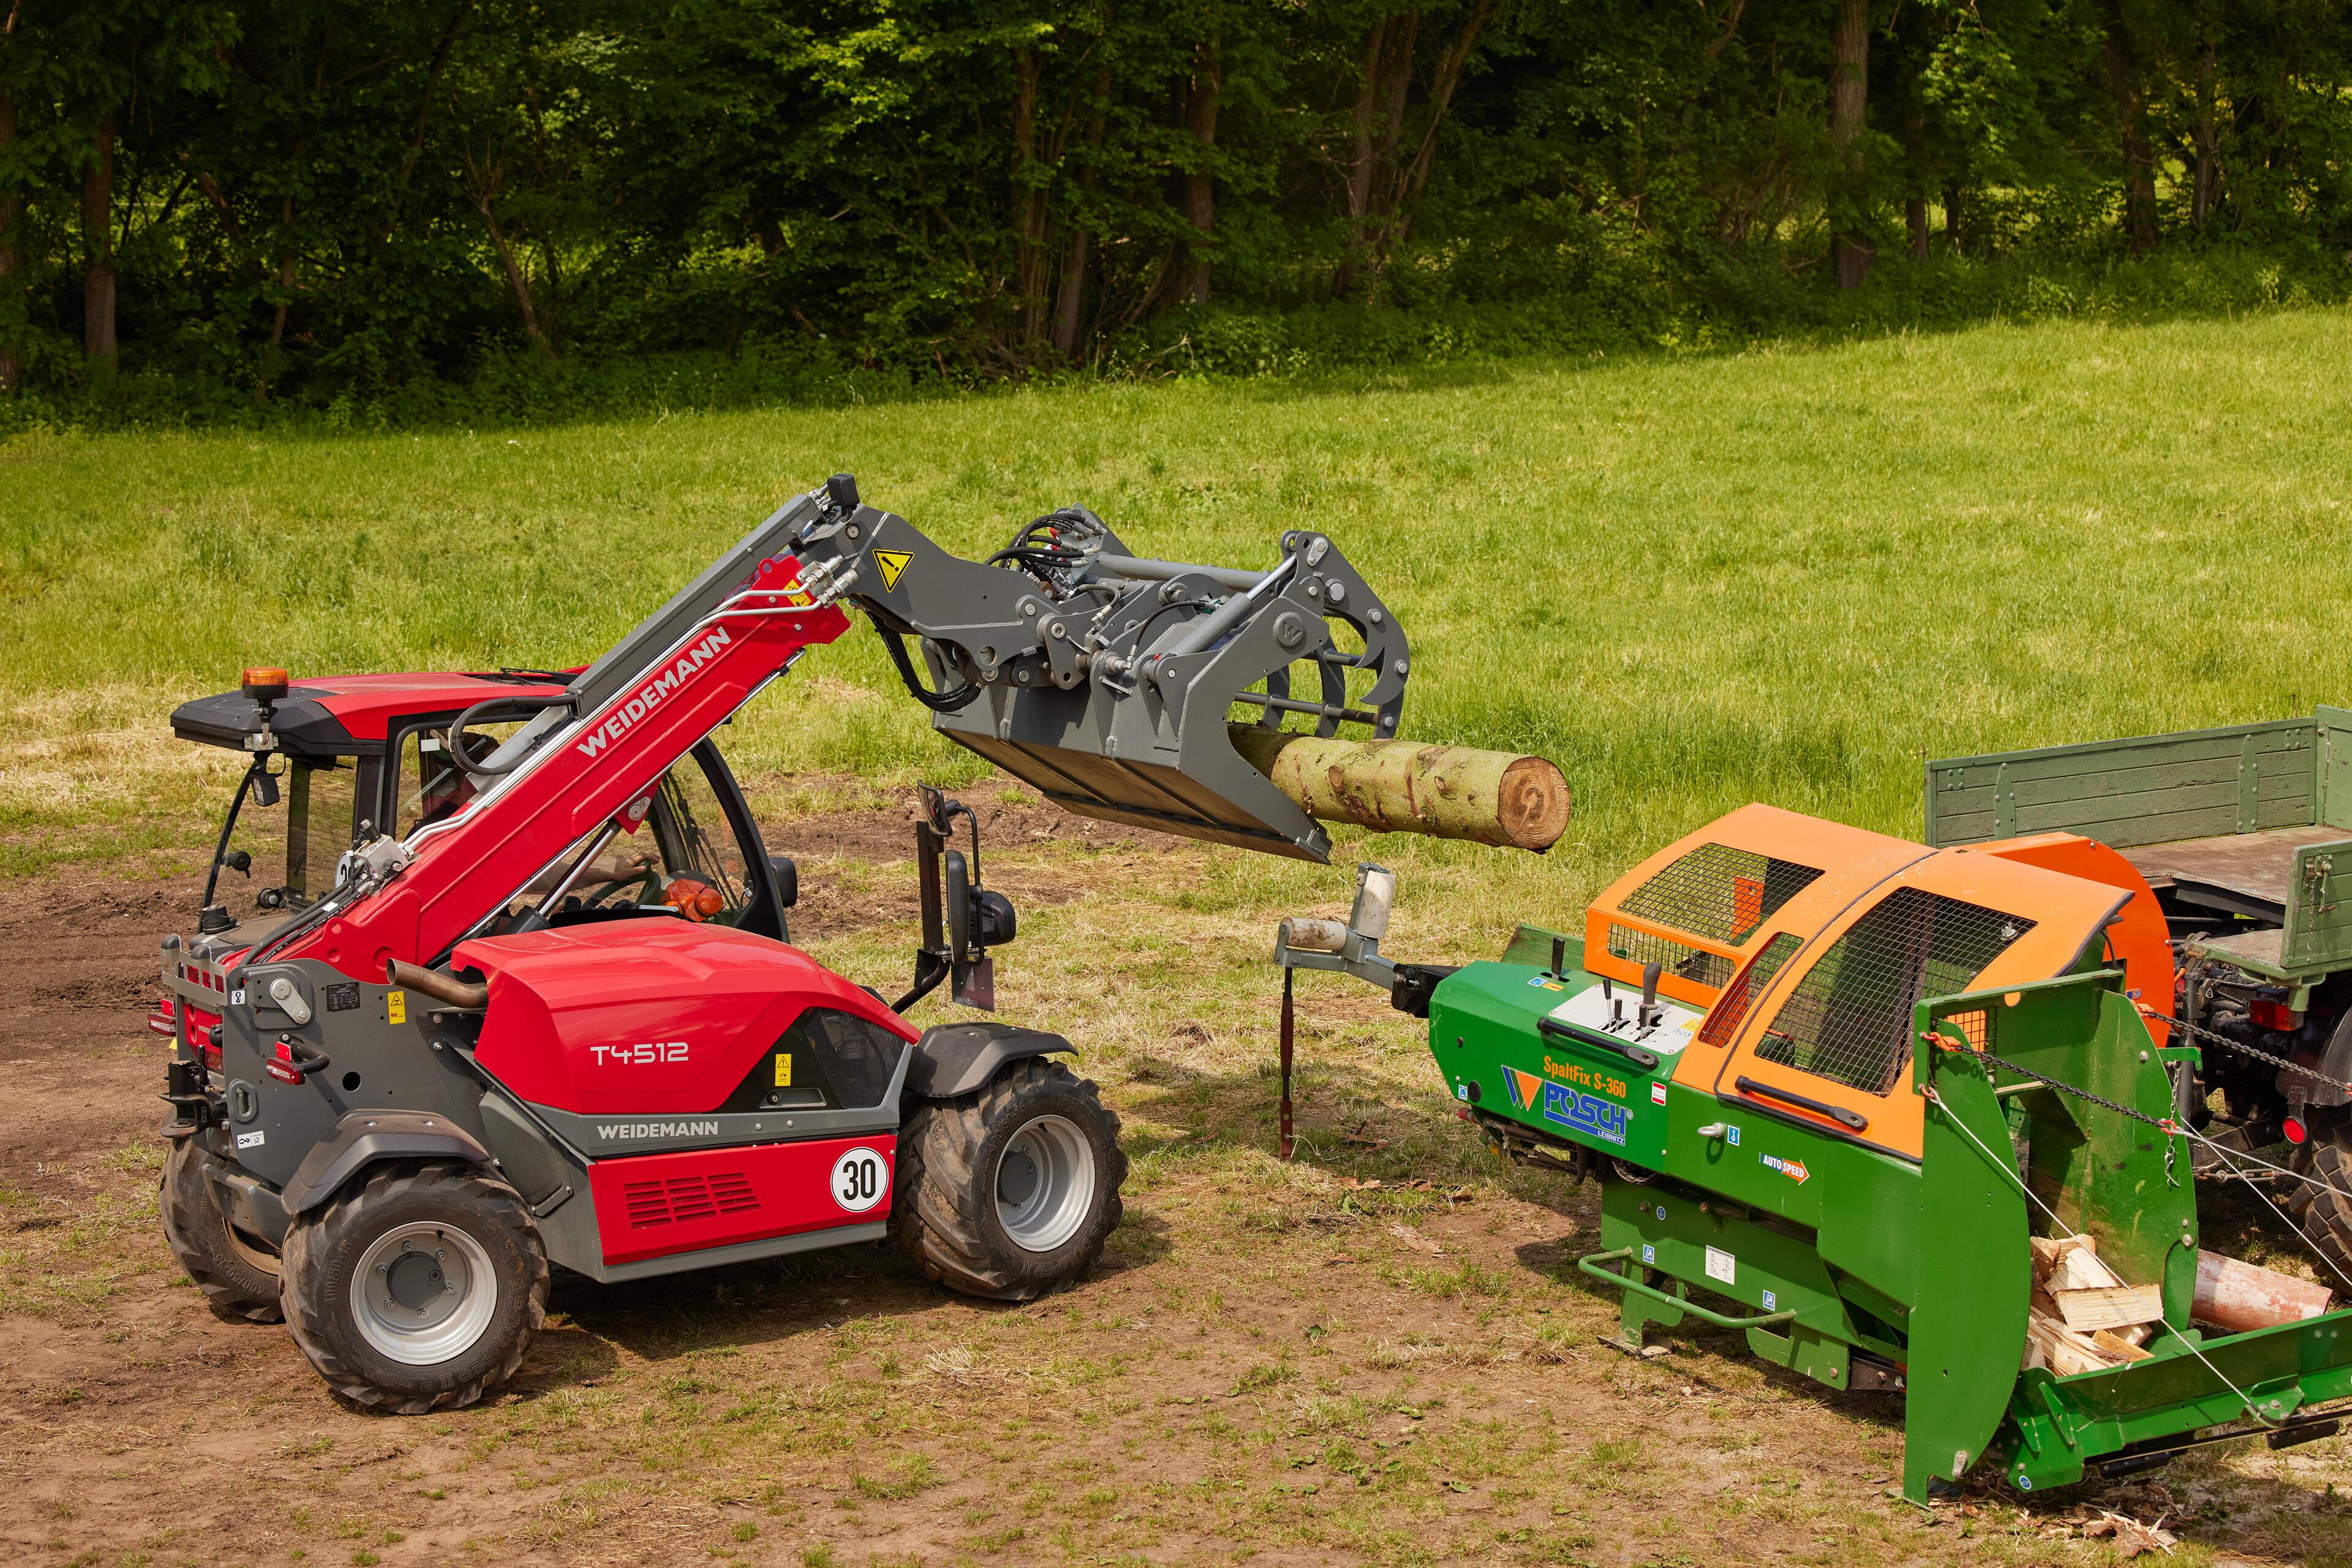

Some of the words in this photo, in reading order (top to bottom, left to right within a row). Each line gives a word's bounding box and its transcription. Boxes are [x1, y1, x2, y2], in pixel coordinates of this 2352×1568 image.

[576, 626, 731, 758] WEIDEMANN
[590, 1042, 688, 1066] T4512
[1544, 1055, 1591, 1087] SpaltFix
[1594, 1072, 1626, 1098] S-360
[1544, 1080, 1626, 1136] POSCH
[597, 1121, 718, 1139] WEIDEMANN
[1597, 1129, 1624, 1145] LEIBNITZ
[843, 1158, 876, 1200] 30
[1763, 1155, 1782, 1170] AUTO
[1782, 1162, 1804, 1178] SPEED
